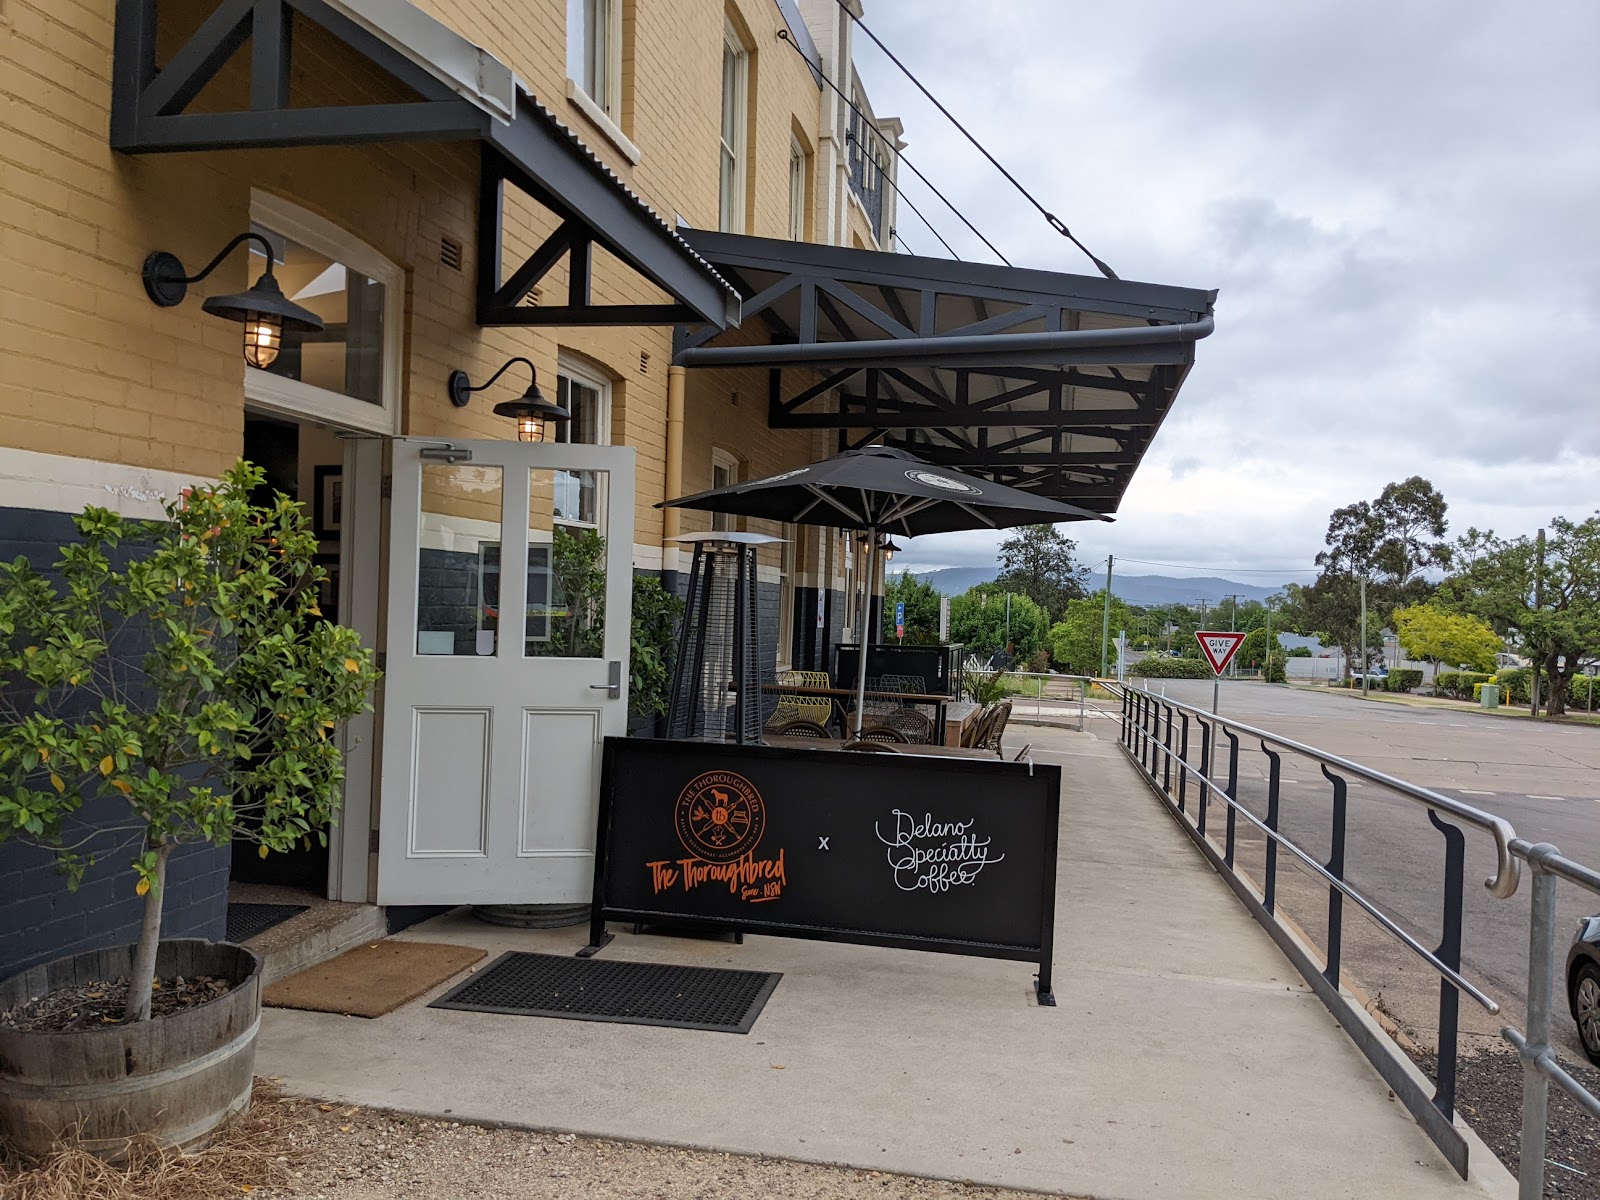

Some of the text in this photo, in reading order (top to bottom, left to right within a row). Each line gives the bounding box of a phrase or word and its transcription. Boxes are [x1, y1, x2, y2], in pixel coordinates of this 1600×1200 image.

[897, 611, 903, 624] P
[1209, 639, 1231, 647] GIVE
[682, 774, 759, 812] THE THOROUGHBRED
[875, 808, 974, 848] Delano
[646, 848, 786, 895] The Thoroughbred
[887, 832, 1005, 877] Specialty
[763, 880, 781, 898] NSW
